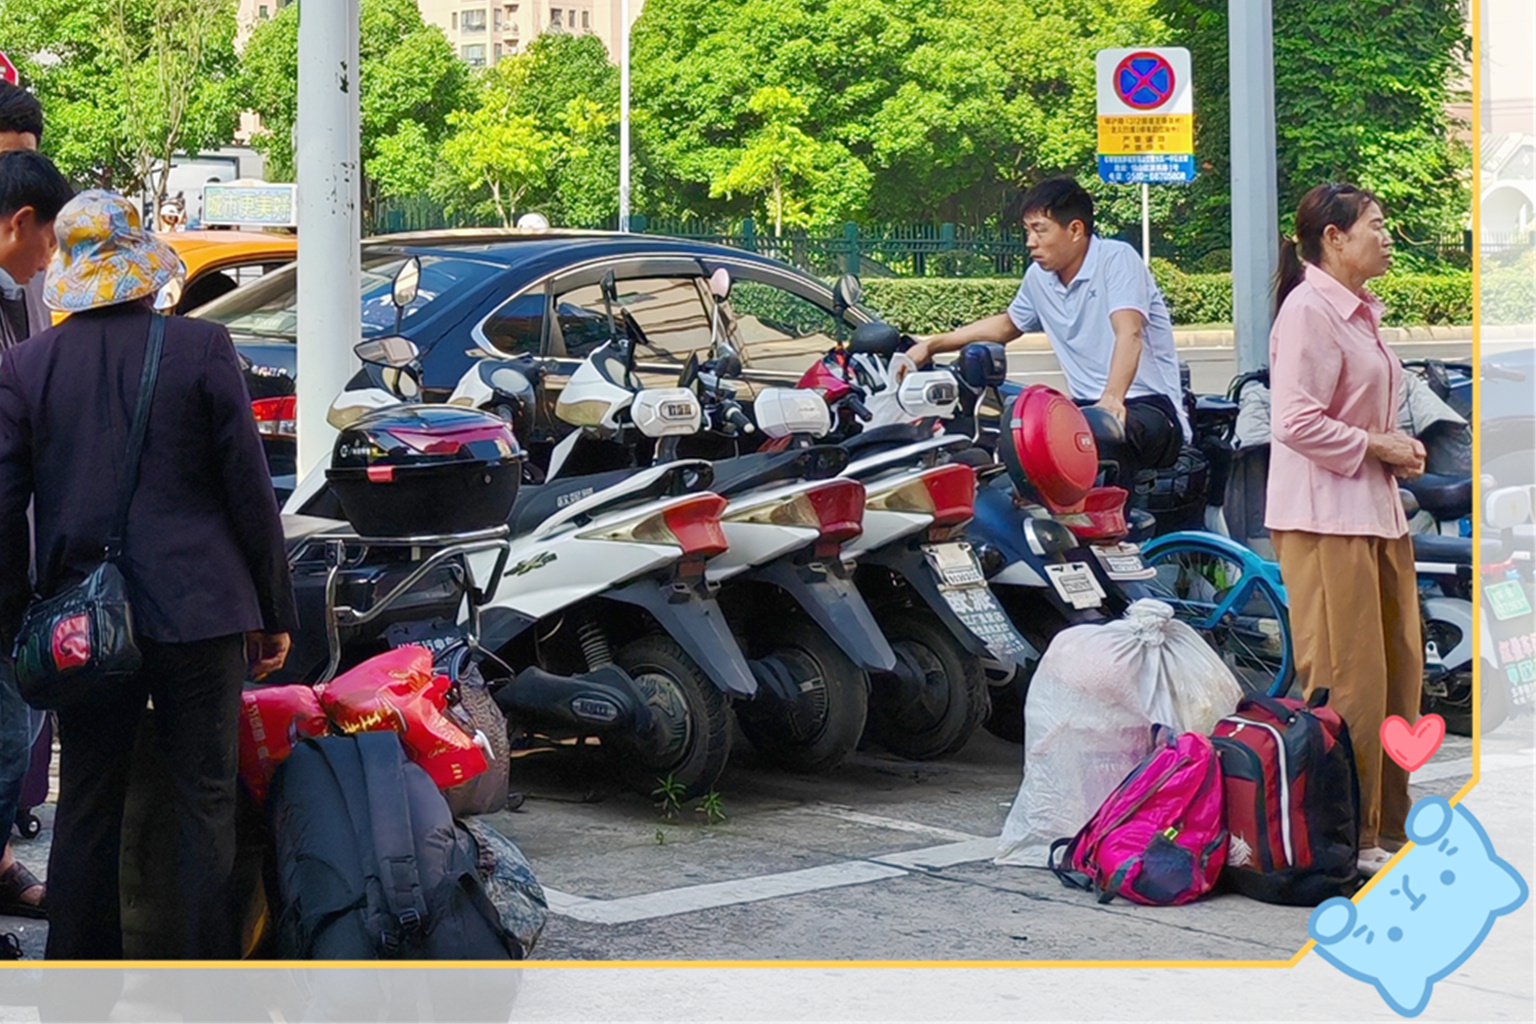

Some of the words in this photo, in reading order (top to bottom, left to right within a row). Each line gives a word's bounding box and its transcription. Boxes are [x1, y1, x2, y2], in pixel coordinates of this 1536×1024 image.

[208, 193, 291, 220] 城市更美好
